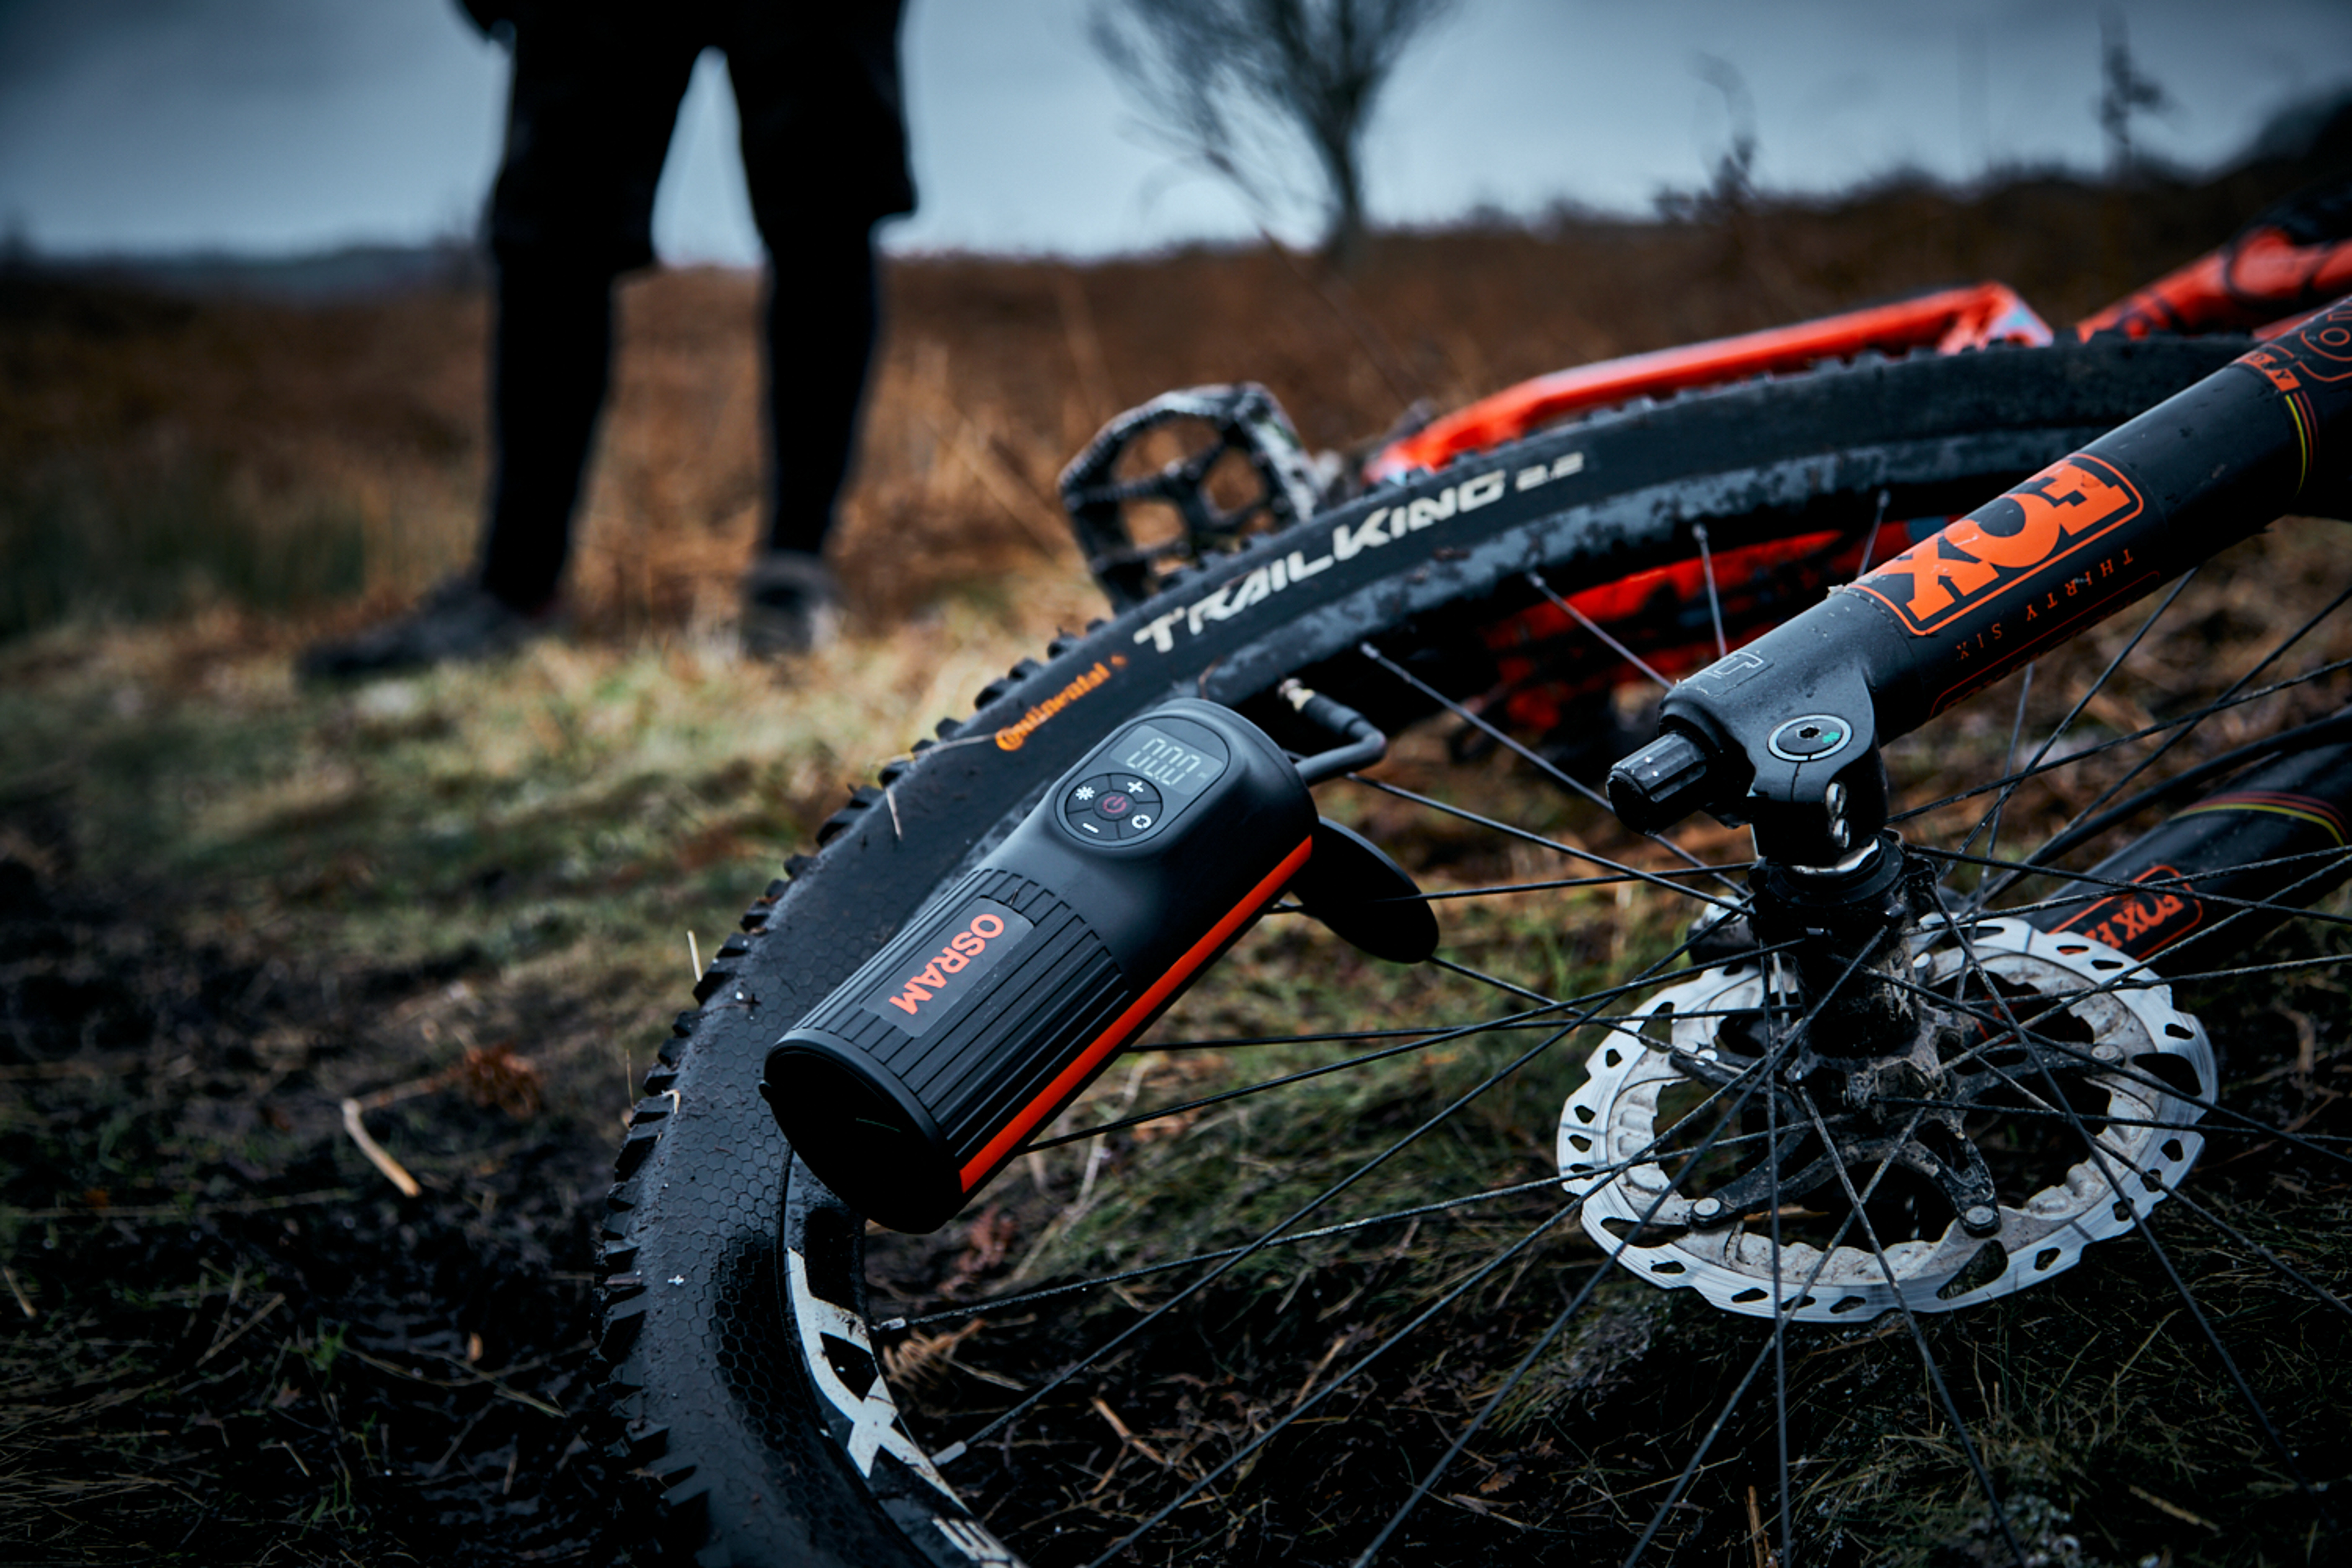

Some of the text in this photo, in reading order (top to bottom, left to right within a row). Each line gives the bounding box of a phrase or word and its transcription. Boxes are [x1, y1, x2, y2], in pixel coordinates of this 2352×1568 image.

[1875, 459, 2131, 622] FOX
[2027, 549, 2133, 622] THIRTY
[1956, 623, 2002, 660] SIX
[889, 913, 1004, 1015] OSRAM
